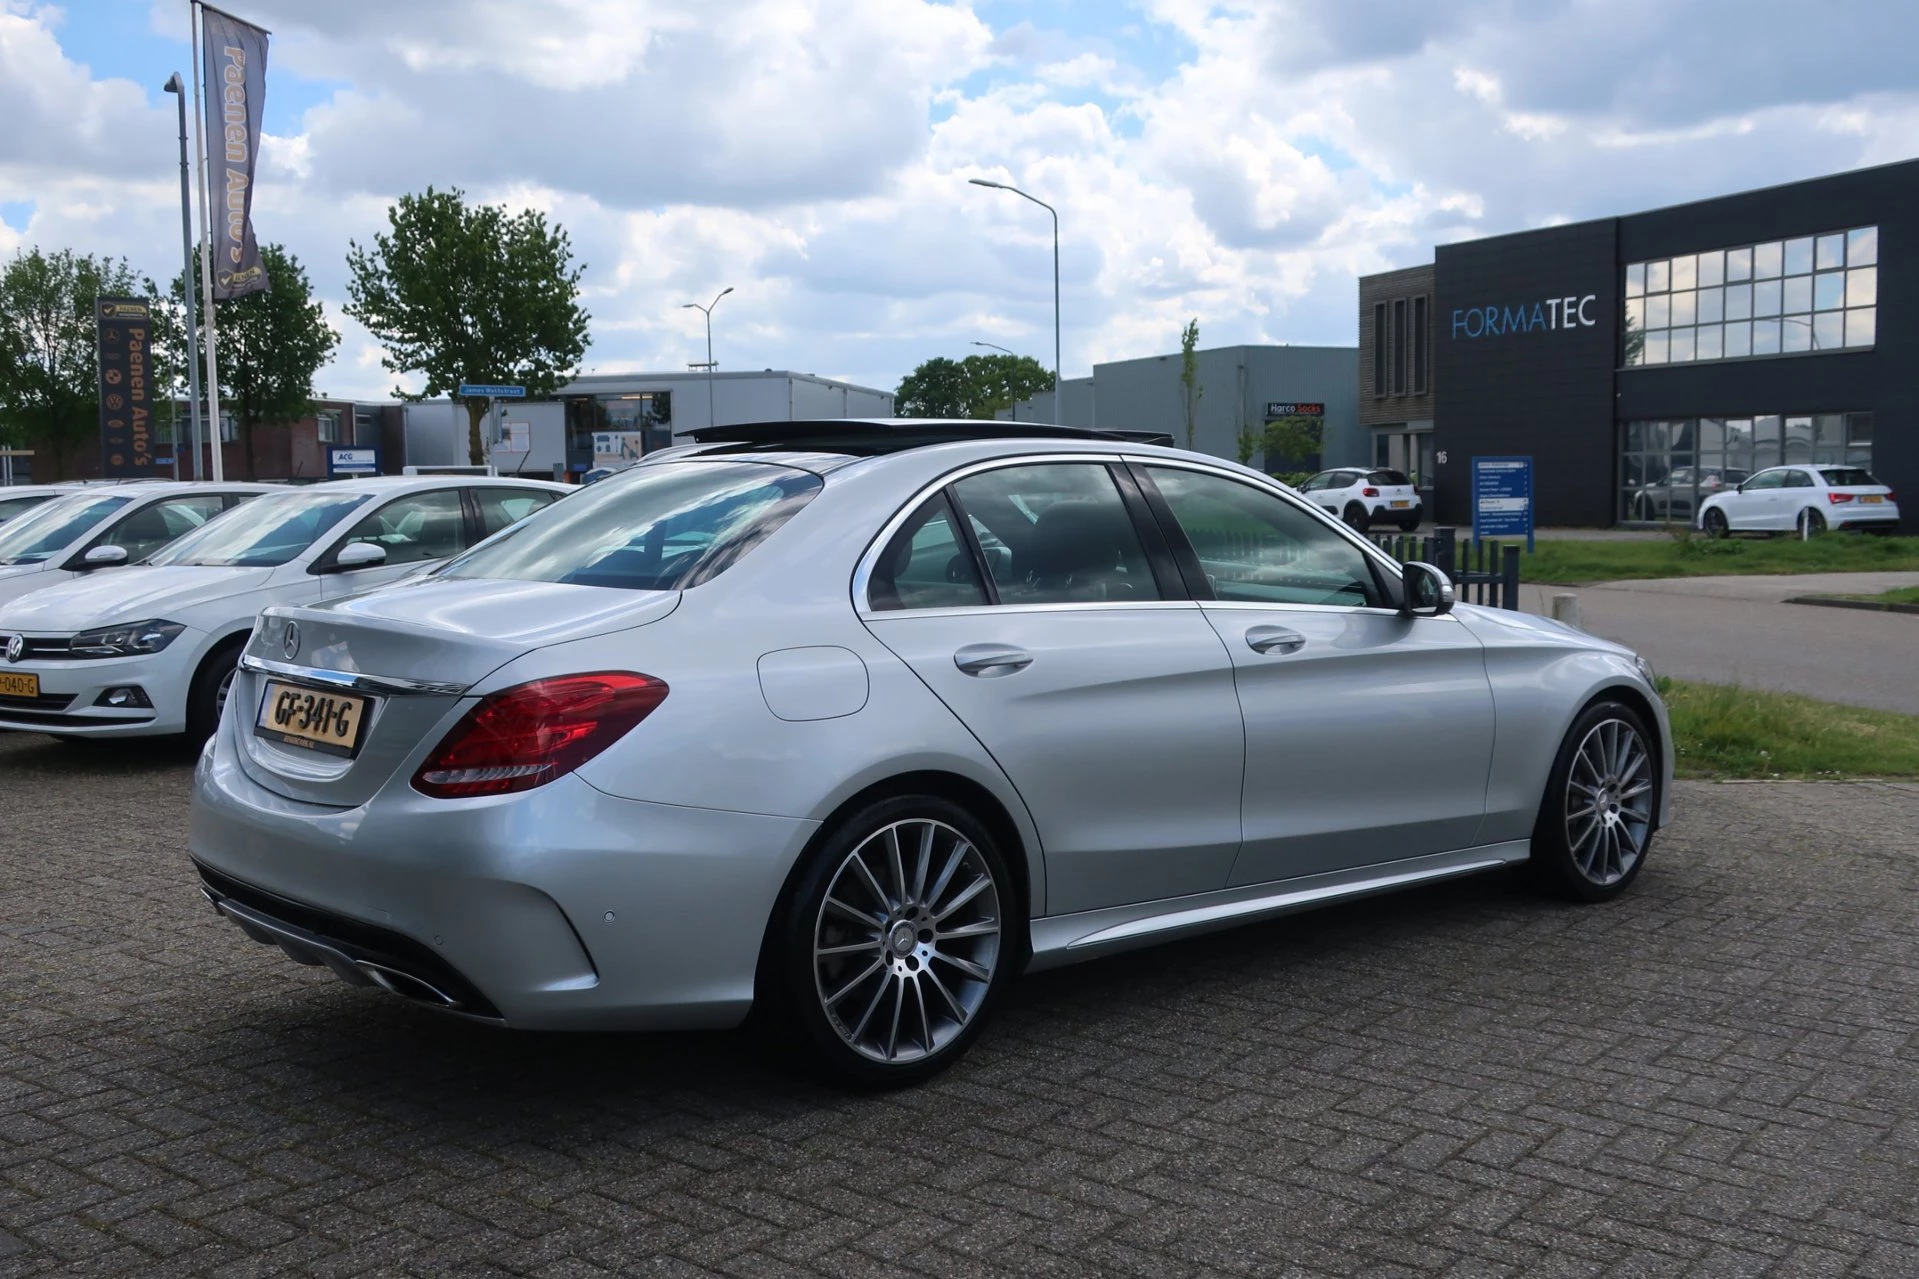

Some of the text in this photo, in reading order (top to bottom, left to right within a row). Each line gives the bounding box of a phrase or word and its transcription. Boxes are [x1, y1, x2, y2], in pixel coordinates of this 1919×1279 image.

[224, 46, 248, 162] Paenen
[1452, 294, 1597, 340] FORMATEC
[129, 328, 145, 401] Paenen
[1271, 403, 1321, 413] Harco Socks
[132, 407, 152, 466] Auto's
[1436, 450, 1448, 464] 16
[0, 676, 34, 693] -040-G
[275, 690, 352, 737] GF-341-G
